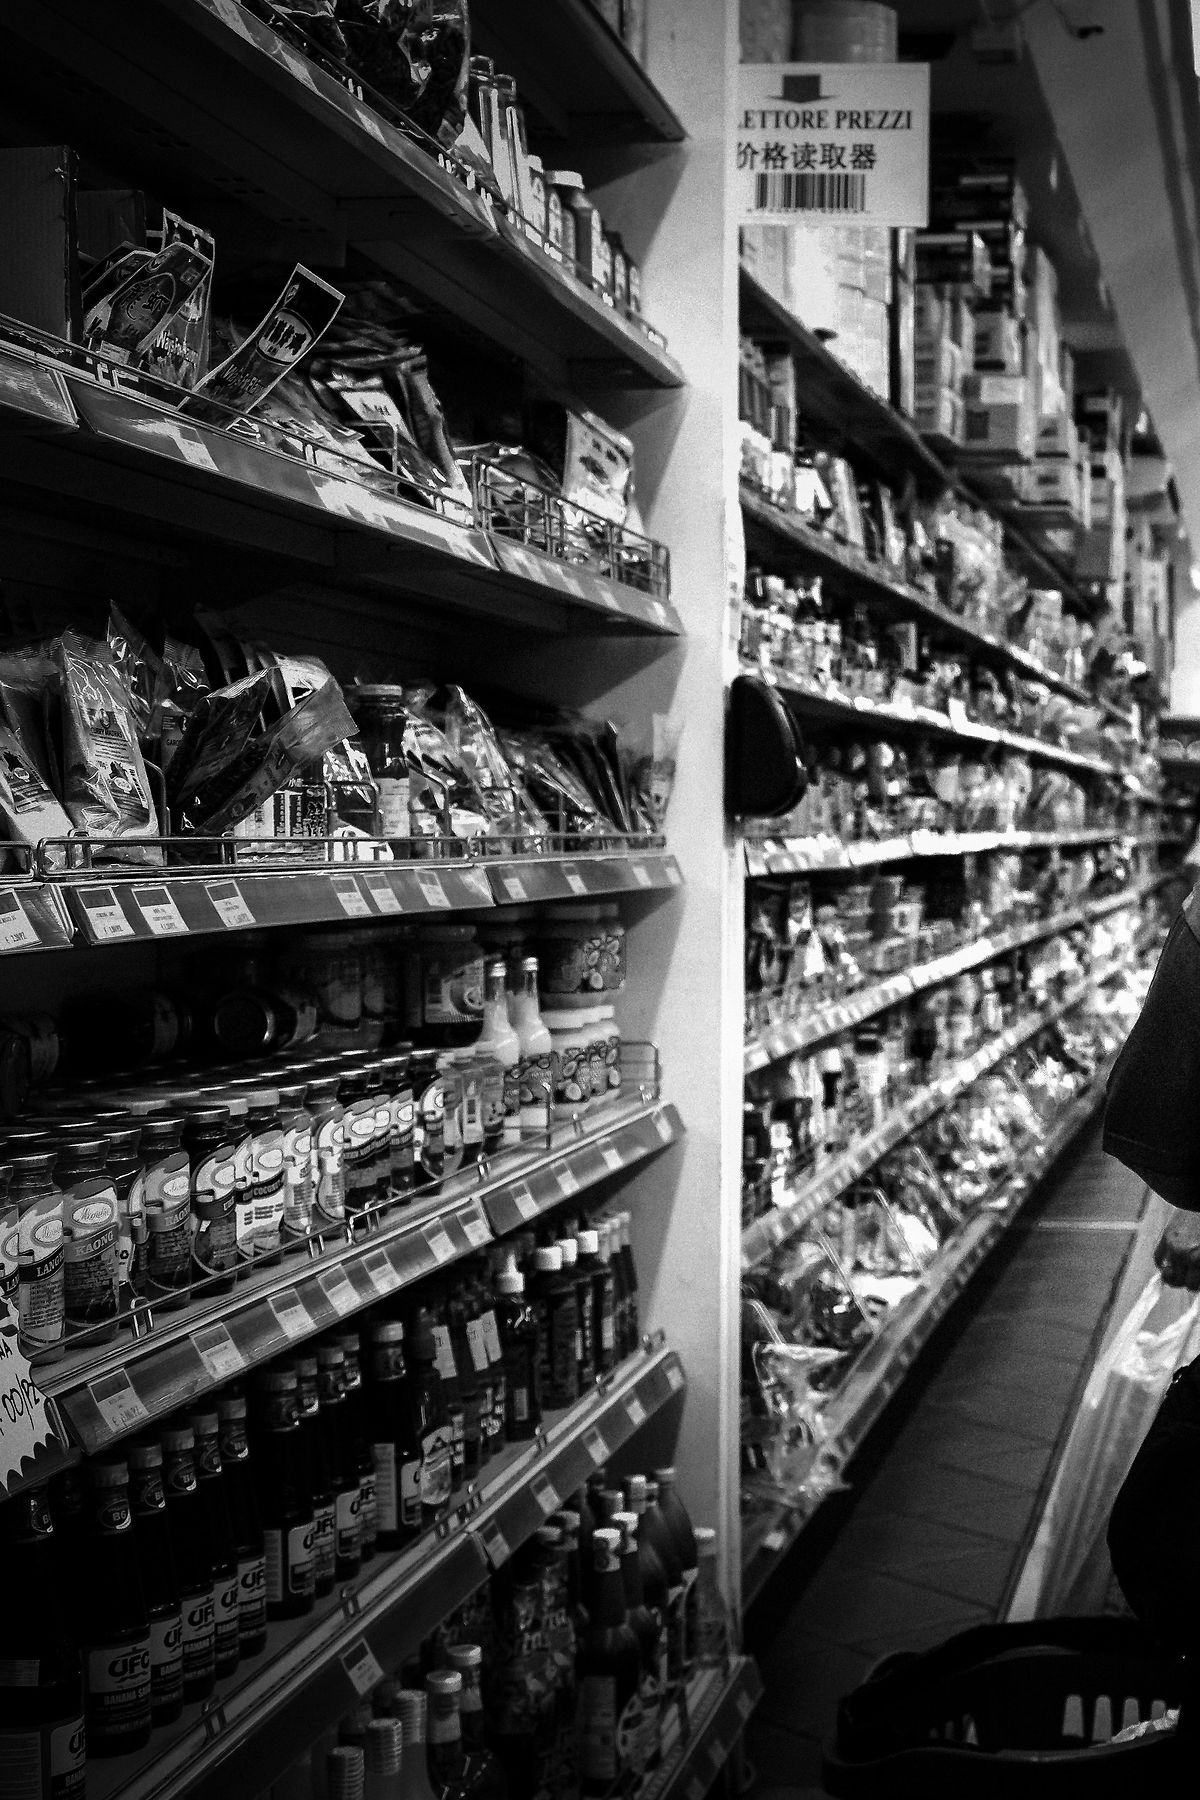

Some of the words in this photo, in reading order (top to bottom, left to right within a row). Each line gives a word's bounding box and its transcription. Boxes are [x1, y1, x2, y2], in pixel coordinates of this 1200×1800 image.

[737, 109, 829, 130] ETTORE
[835, 109, 912, 130] PREZZI
[736, 141, 877, 170] 价格读取器
[77, 1230, 114, 1256] KAONG
[112, 1509, 127, 1522] B6
[108, 1650, 150, 1678] UFC
